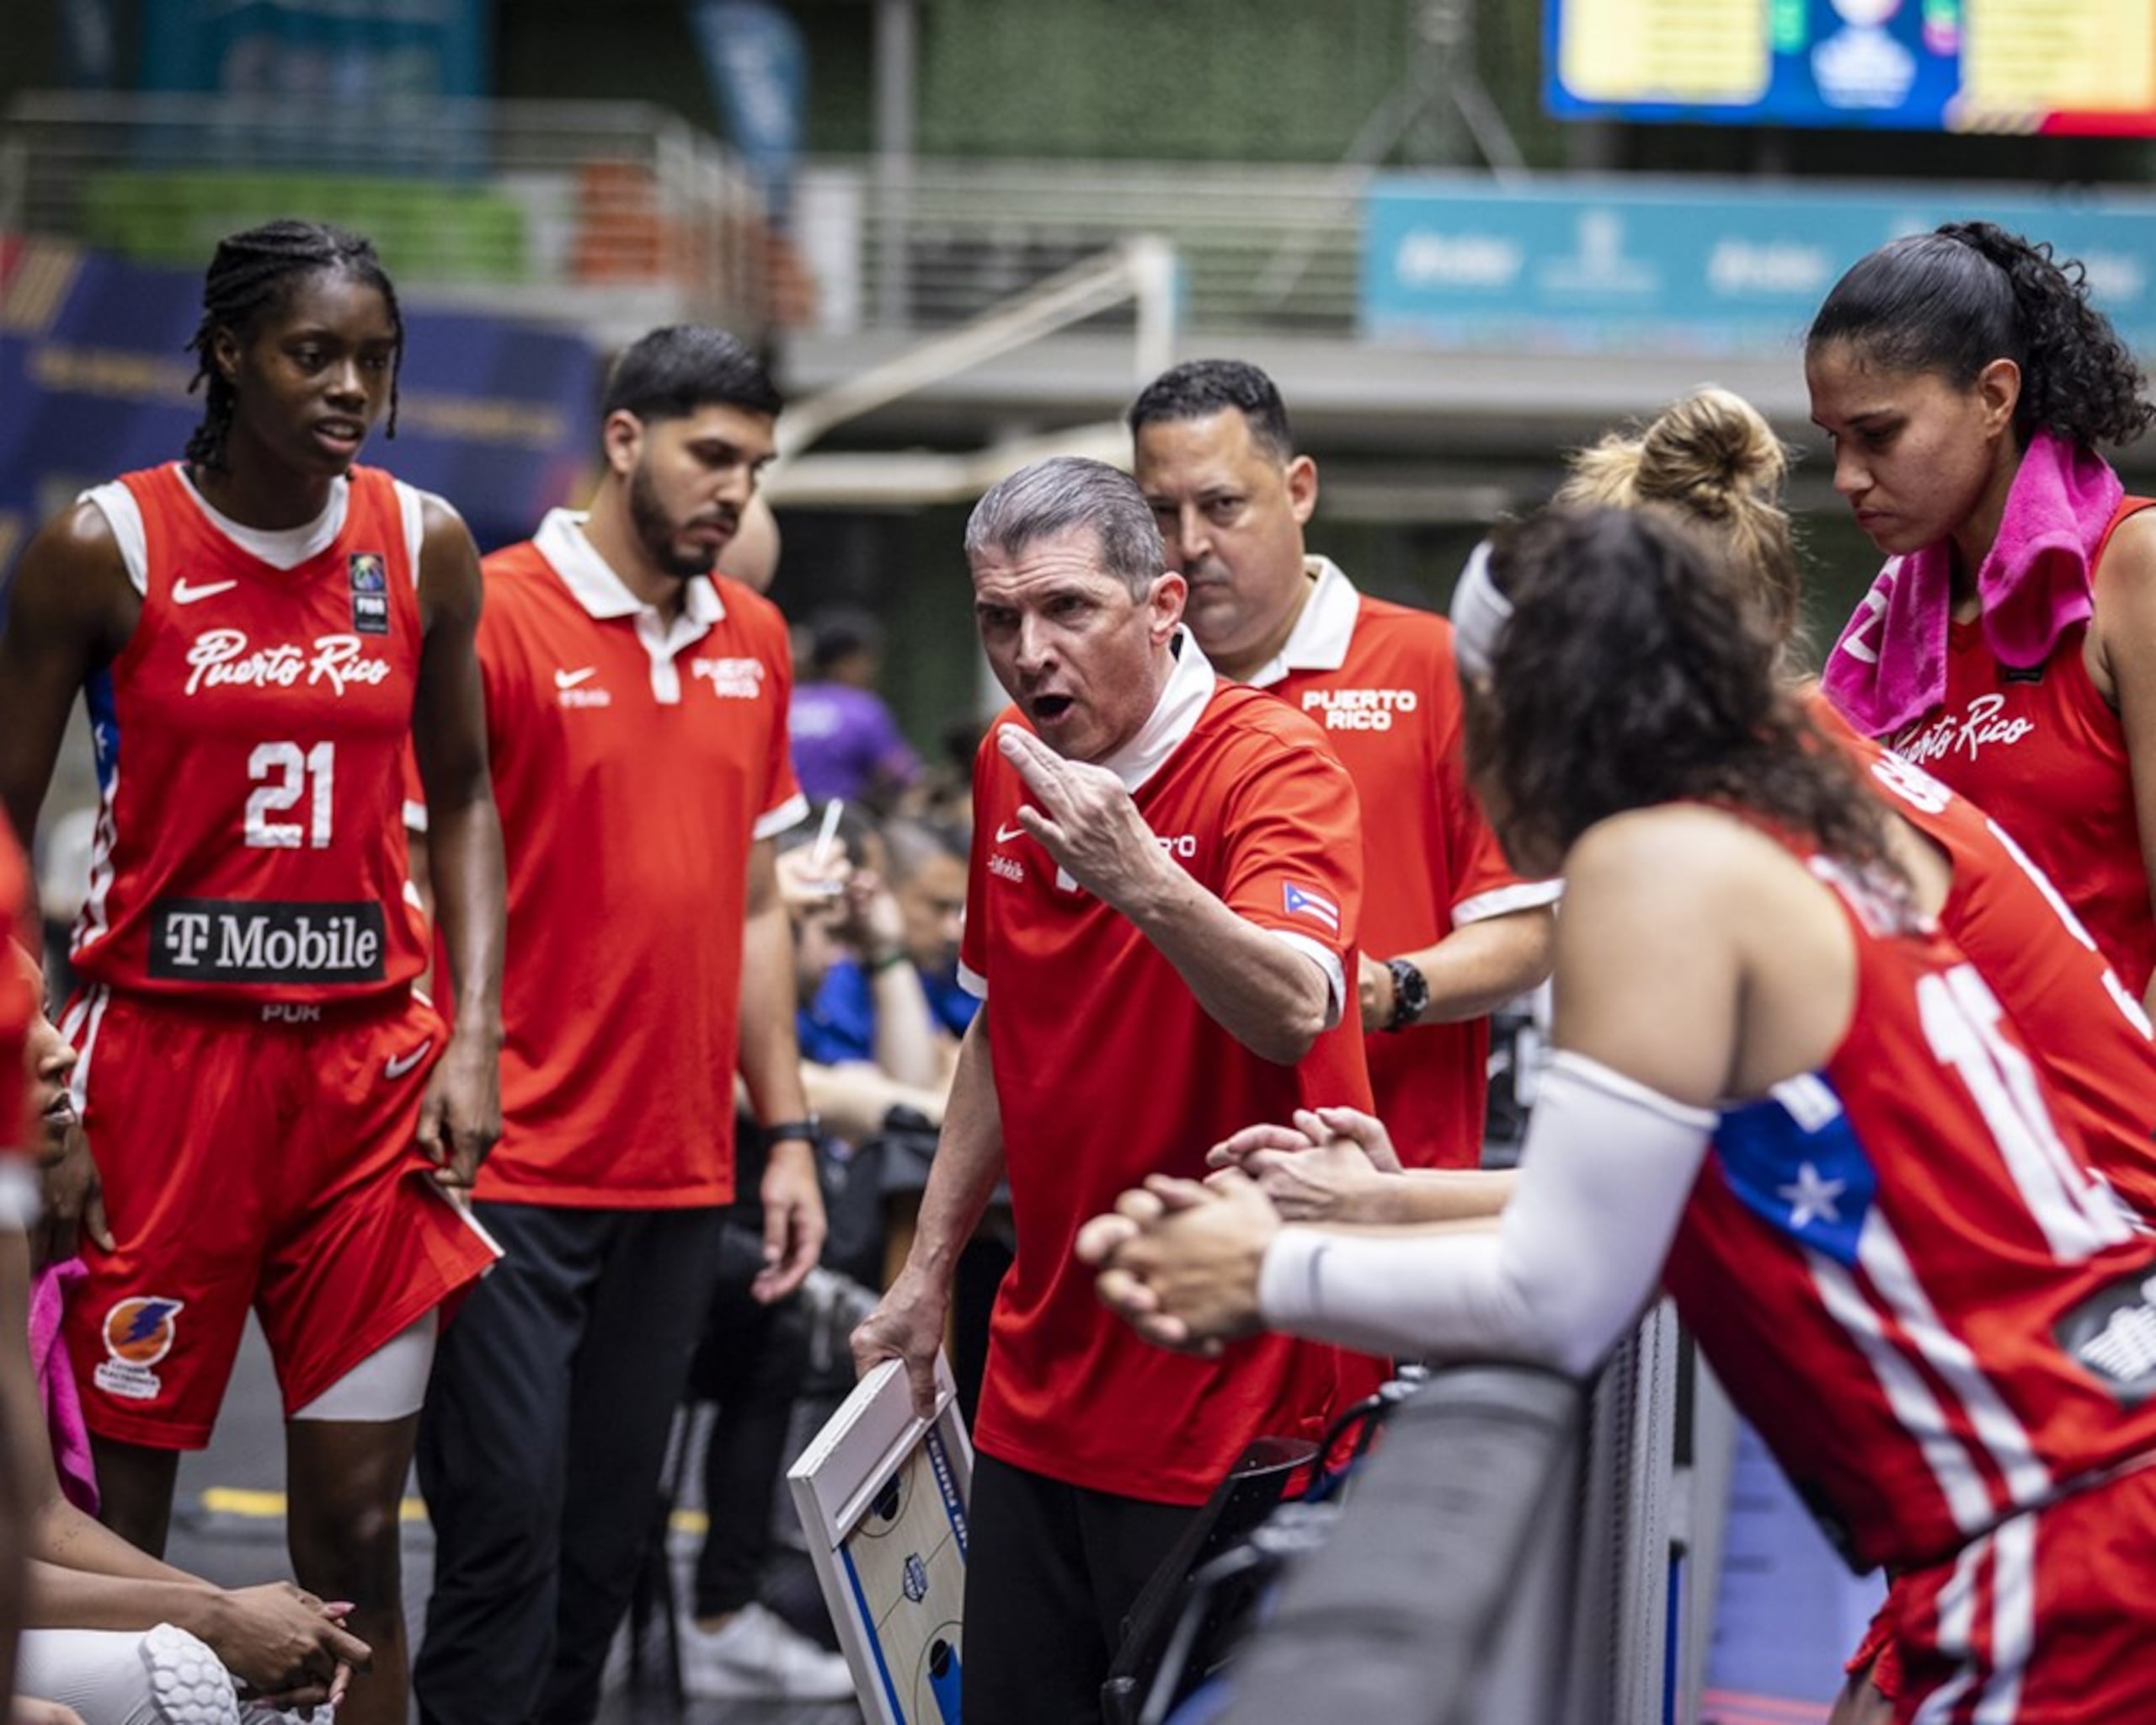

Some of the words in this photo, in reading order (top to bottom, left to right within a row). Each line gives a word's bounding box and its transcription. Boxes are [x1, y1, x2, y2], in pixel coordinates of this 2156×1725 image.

[184, 628, 306, 697] Puerto
[307, 633, 392, 697] Rico
[1302, 689, 1417, 713] PUERTO
[1326, 710, 1392, 731] RICO
[1955, 693, 2035, 761] Rico
[244, 740, 335, 849] 21
[215, 914, 378, 969] Mobile
